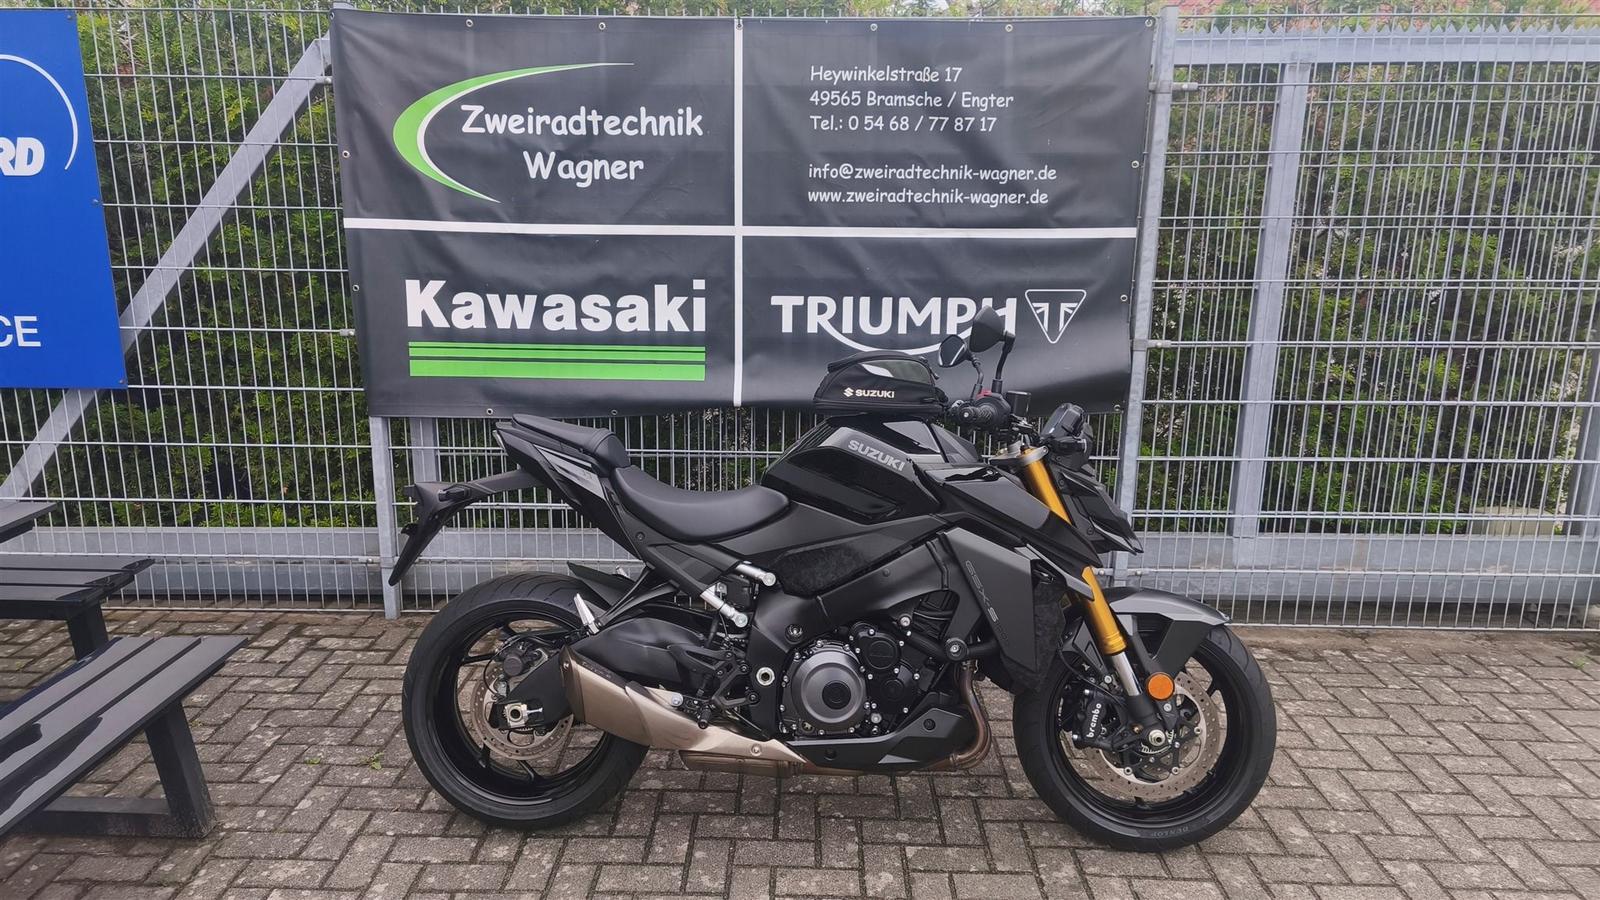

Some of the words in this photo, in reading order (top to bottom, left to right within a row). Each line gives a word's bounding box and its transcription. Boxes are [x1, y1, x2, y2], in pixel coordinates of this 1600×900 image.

[810, 65, 939, 85] Heywinkelstraße
[945, 66, 963, 83] 17
[809, 90, 861, 107] 49565
[866, 91, 942, 107] Bramsche
[946, 91, 957, 108] /
[961, 91, 1014, 112] Engter
[460, 105, 704, 137] Zweiradtechnik
[810, 115, 843, 131] Tel.:
[848, 116, 859, 131] 0
[863, 115, 884, 131] 54
[889, 115, 910, 131] 68
[914, 115, 924, 132] /
[928, 116, 949, 132] 77
[954, 116, 976, 132] 87
[979, 116, 998, 132] 17
[523, 151, 645, 188] Wagner
[808, 163, 1058, 184] info@zweiradtechnik-wagner.de
[808, 188, 1049, 208] www.zweiradtechnik-wagner.de
[405, 279, 706, 333] Kawasaki
[771, 296, 1017, 348] TRIUMPH
[855, 389, 895, 399] SUZUKI
[847, 439, 906, 471] SUZUKI
[1086, 703, 1102, 738] brembo
